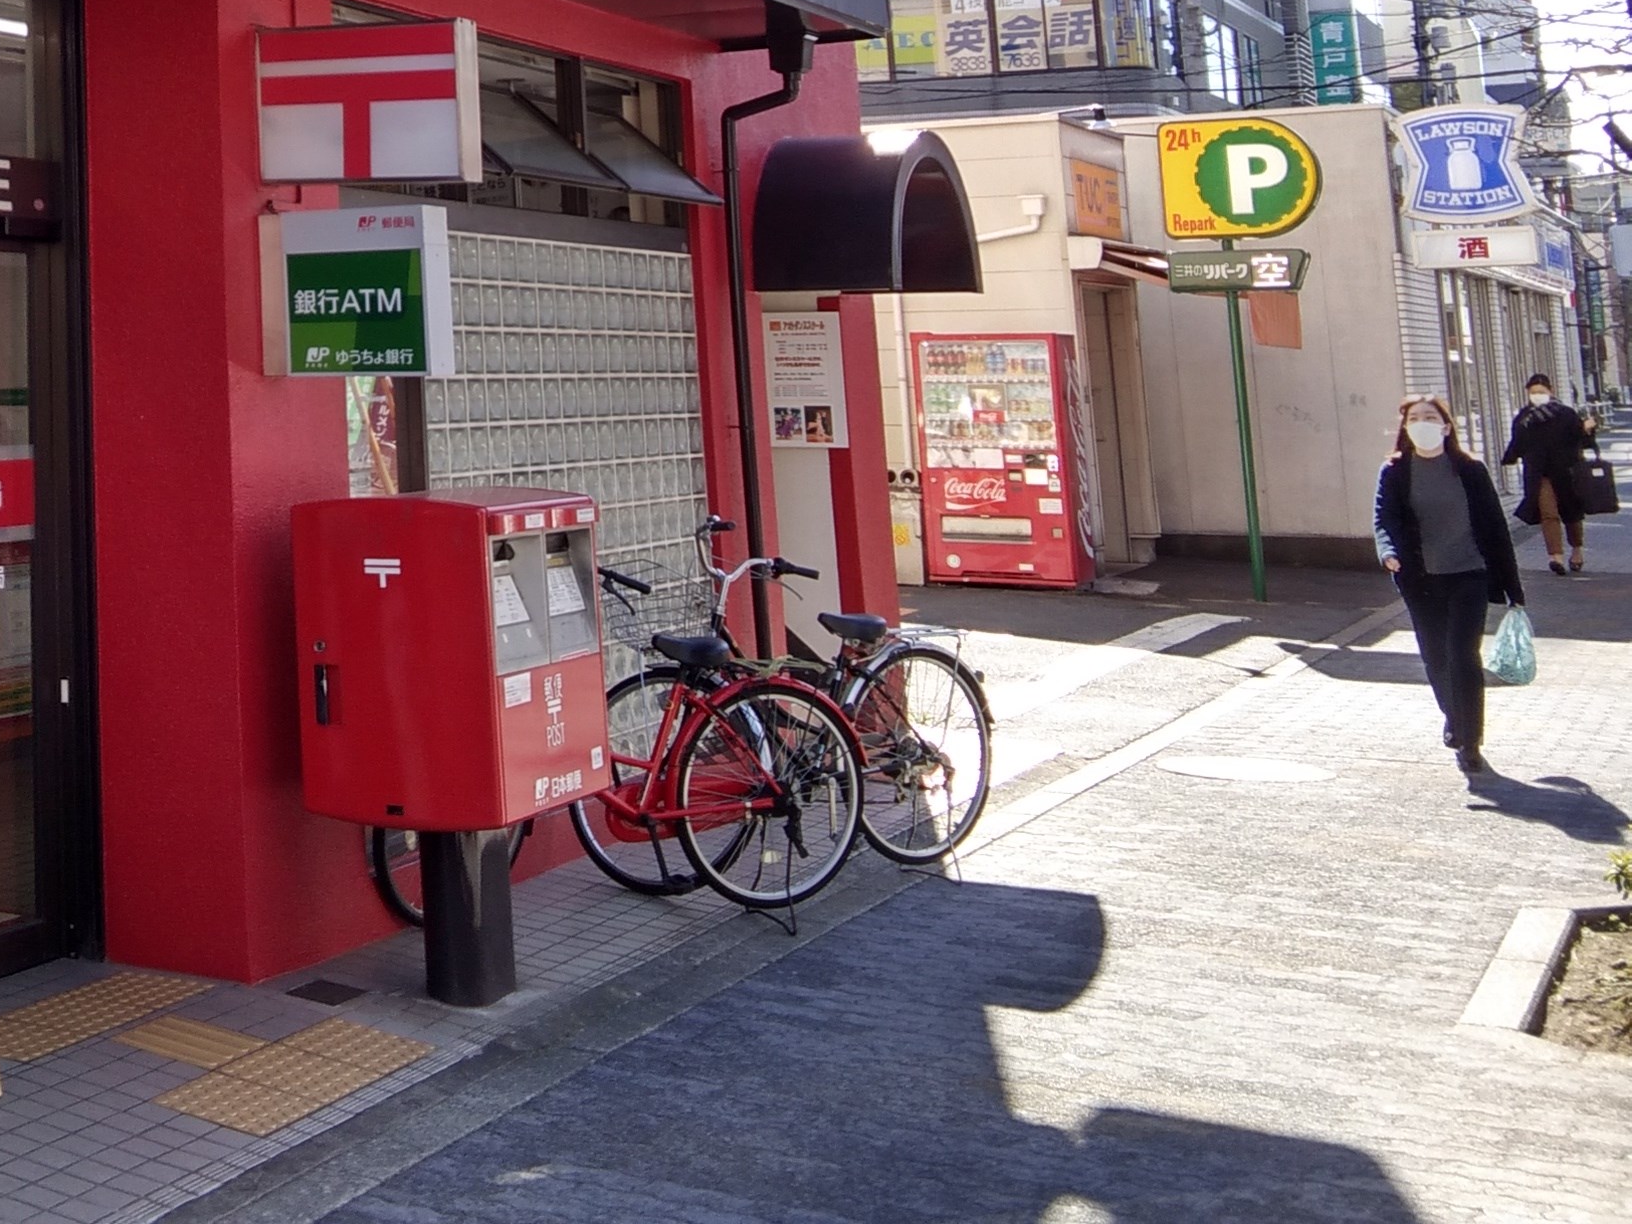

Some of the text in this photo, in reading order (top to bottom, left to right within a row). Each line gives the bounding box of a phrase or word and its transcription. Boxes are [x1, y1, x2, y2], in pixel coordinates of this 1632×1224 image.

[945, 9, 1093, 56] 英会話
[1414, 120, 1505, 142] LAWSON
[1226, 143, 1288, 215] P
[1423, 185, 1514, 206] STATION
[1172, 213, 1217, 234] Repark
[1457, 236, 1490, 260] 酒
[1251, 253, 1291, 287] 空
[293, 287, 403, 315] 銀行ATM
[335, 348, 414, 366] ゆうちょ銀行
[944, 477, 1007, 502] Coca-Cola
[547, 722, 565, 748] POST
[551, 769, 582, 798] 日本郵便
